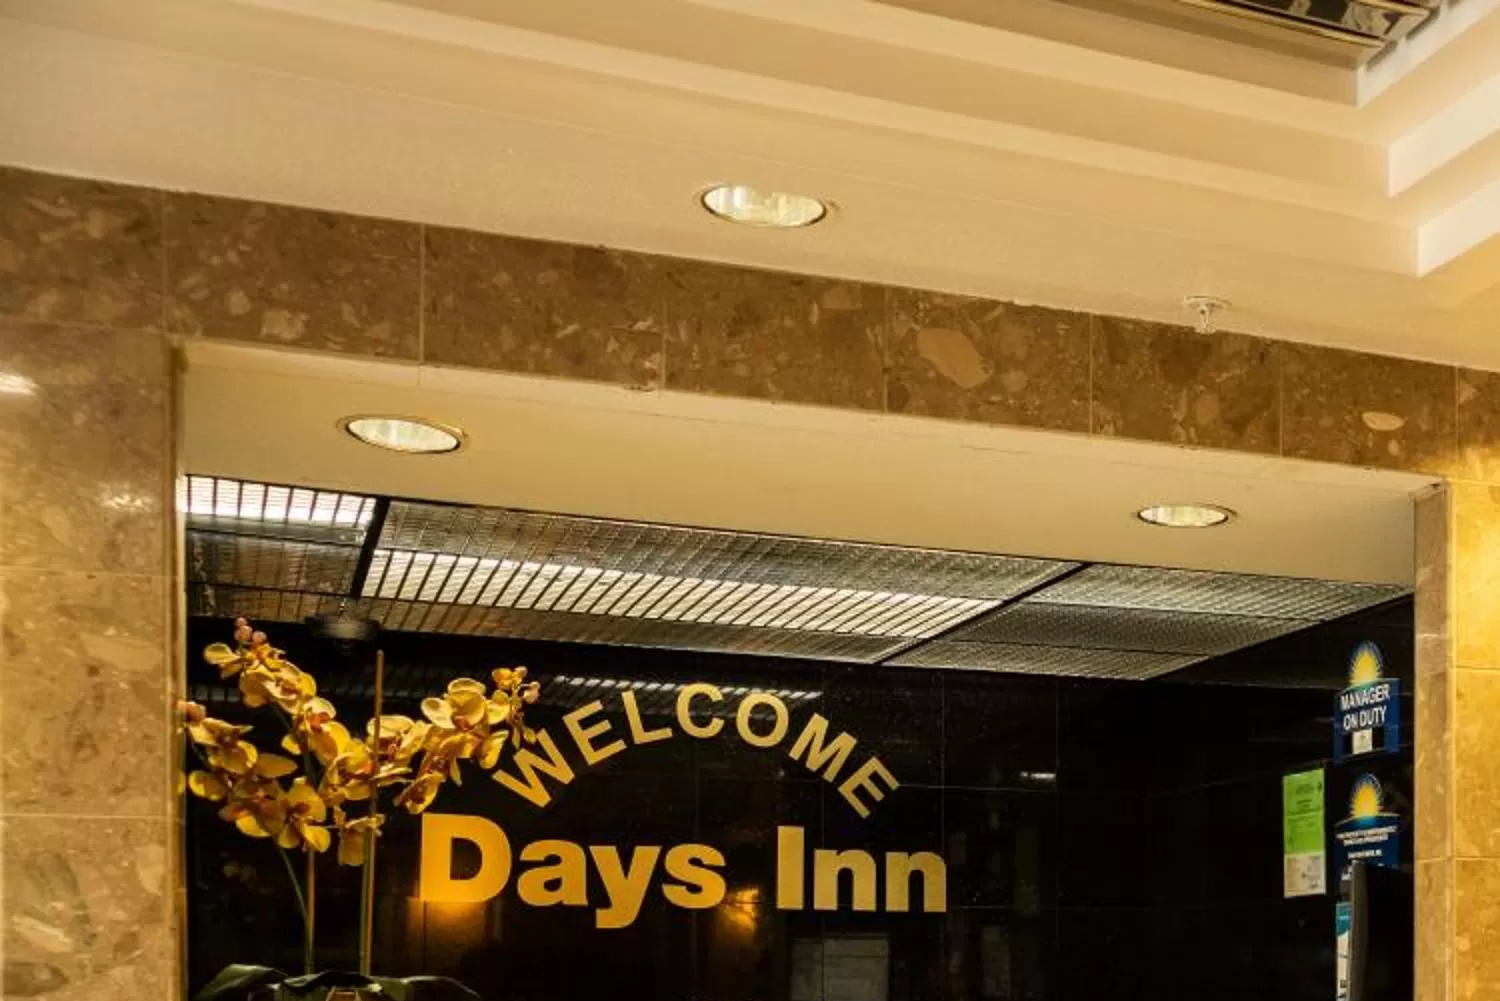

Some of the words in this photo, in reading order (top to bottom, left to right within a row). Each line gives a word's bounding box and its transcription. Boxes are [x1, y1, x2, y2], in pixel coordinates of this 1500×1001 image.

[1340, 683, 1391, 711] MANAGER
[1343, 711, 1359, 731] ON
[1360, 705, 1387, 727] DUTY
[492, 683, 900, 819] WELCOME
[420, 812, 727, 929] Days
[777, 826, 947, 913] Inn
